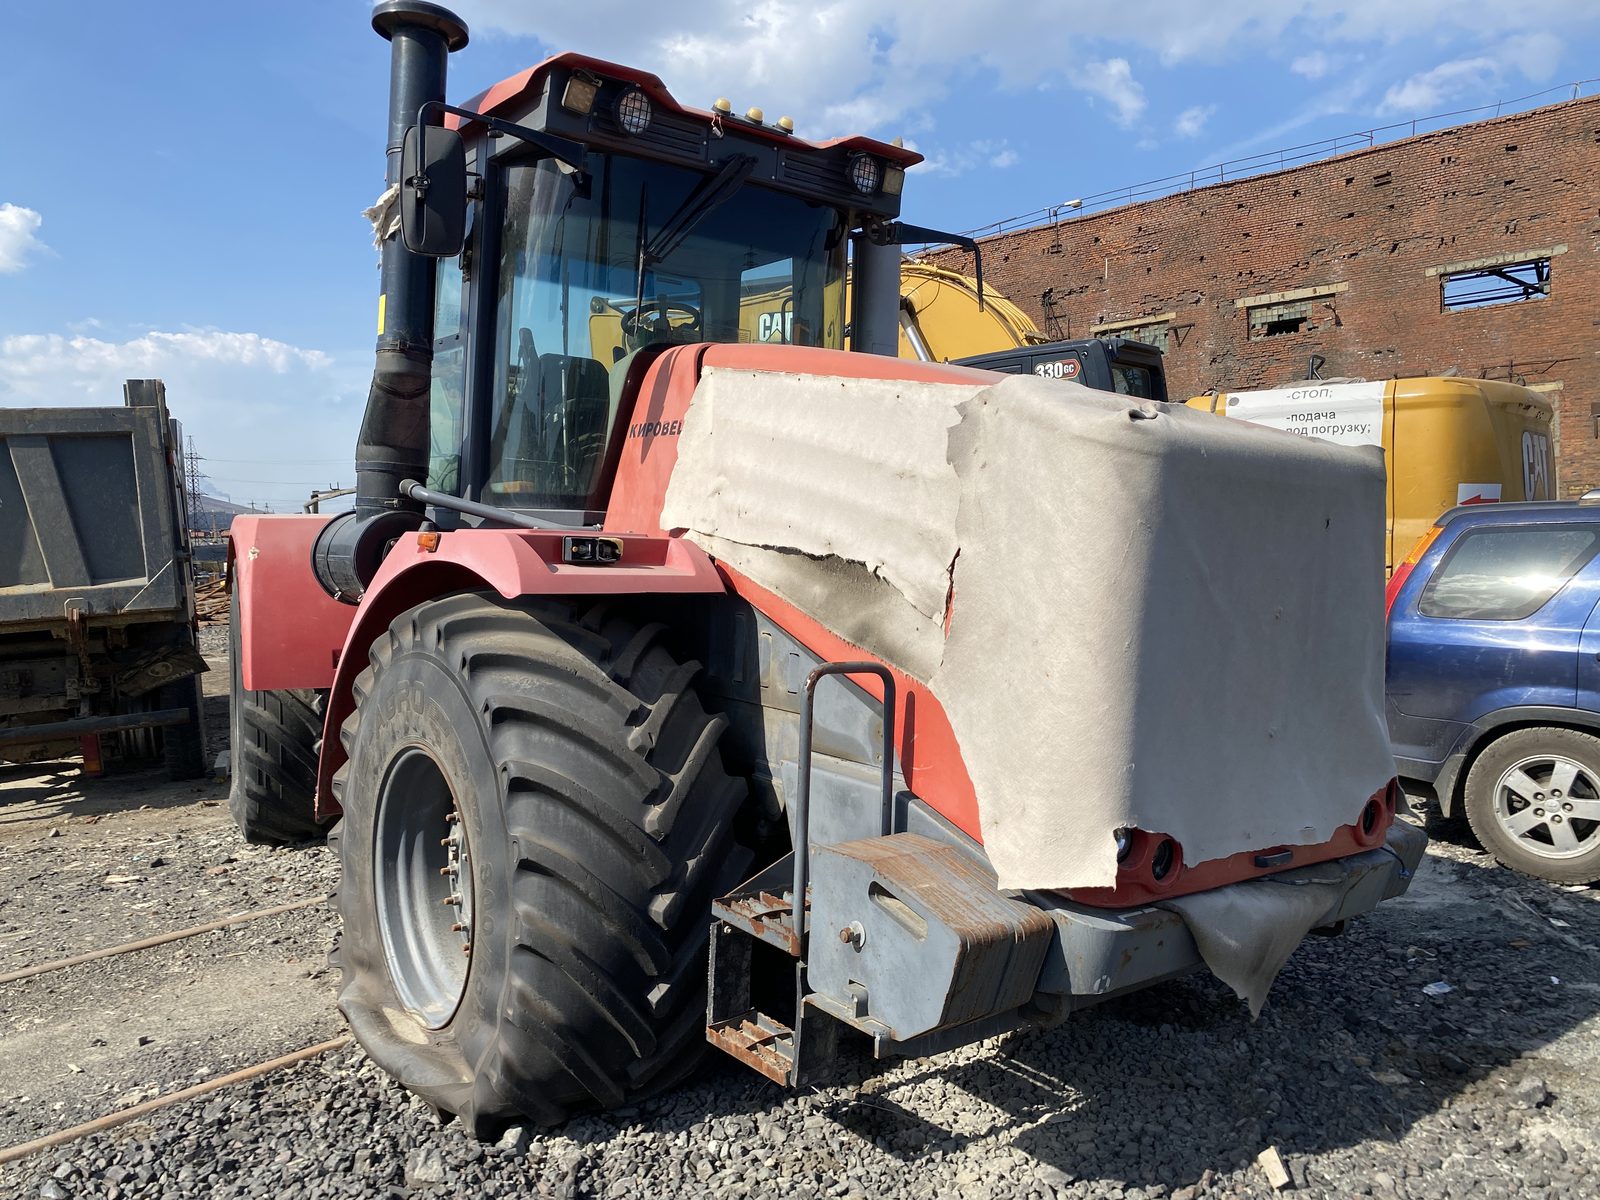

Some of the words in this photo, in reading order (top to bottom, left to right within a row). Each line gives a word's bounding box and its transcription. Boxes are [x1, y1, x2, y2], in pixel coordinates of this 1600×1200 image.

[1035, 362, 1063, 378] 330
[1063, 364, 1075, 374] GC
[1286, 411, 1336, 423] -подача
[1311, 423, 1371, 436] погрузку;
[1522, 431, 1549, 502] CAT
